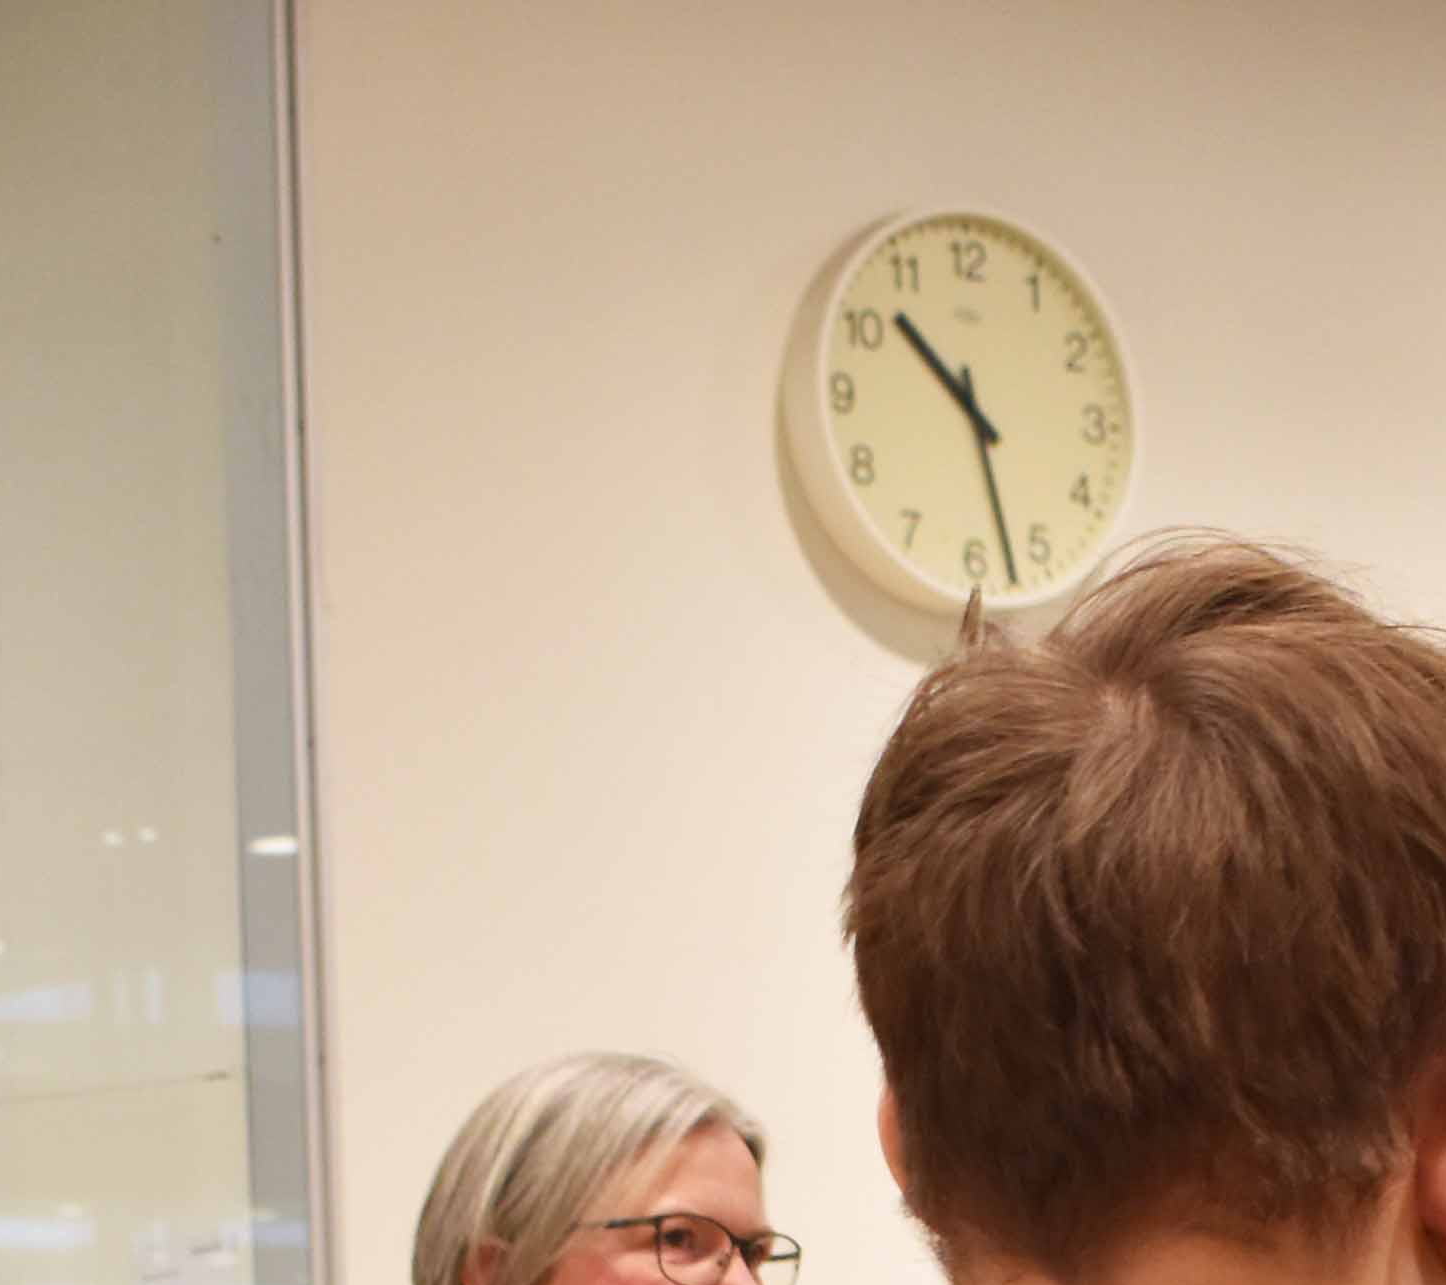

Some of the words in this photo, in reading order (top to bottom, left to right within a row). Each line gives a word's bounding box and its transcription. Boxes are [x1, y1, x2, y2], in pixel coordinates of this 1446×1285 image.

[889, 254, 922, 293] 11
[949, 240, 987, 283] 12
[1025, 273, 1042, 312] 1
[843, 308, 884, 351] 10
[1064, 332, 1089, 374] 2
[830, 371, 855, 414] 9
[1081, 404, 1107, 446] 3
[850, 444, 876, 486] 8
[1068, 474, 1092, 509] 4
[899, 509, 923, 549] 7
[1027, 523, 1052, 563] 5
[963, 538, 989, 580] 6
